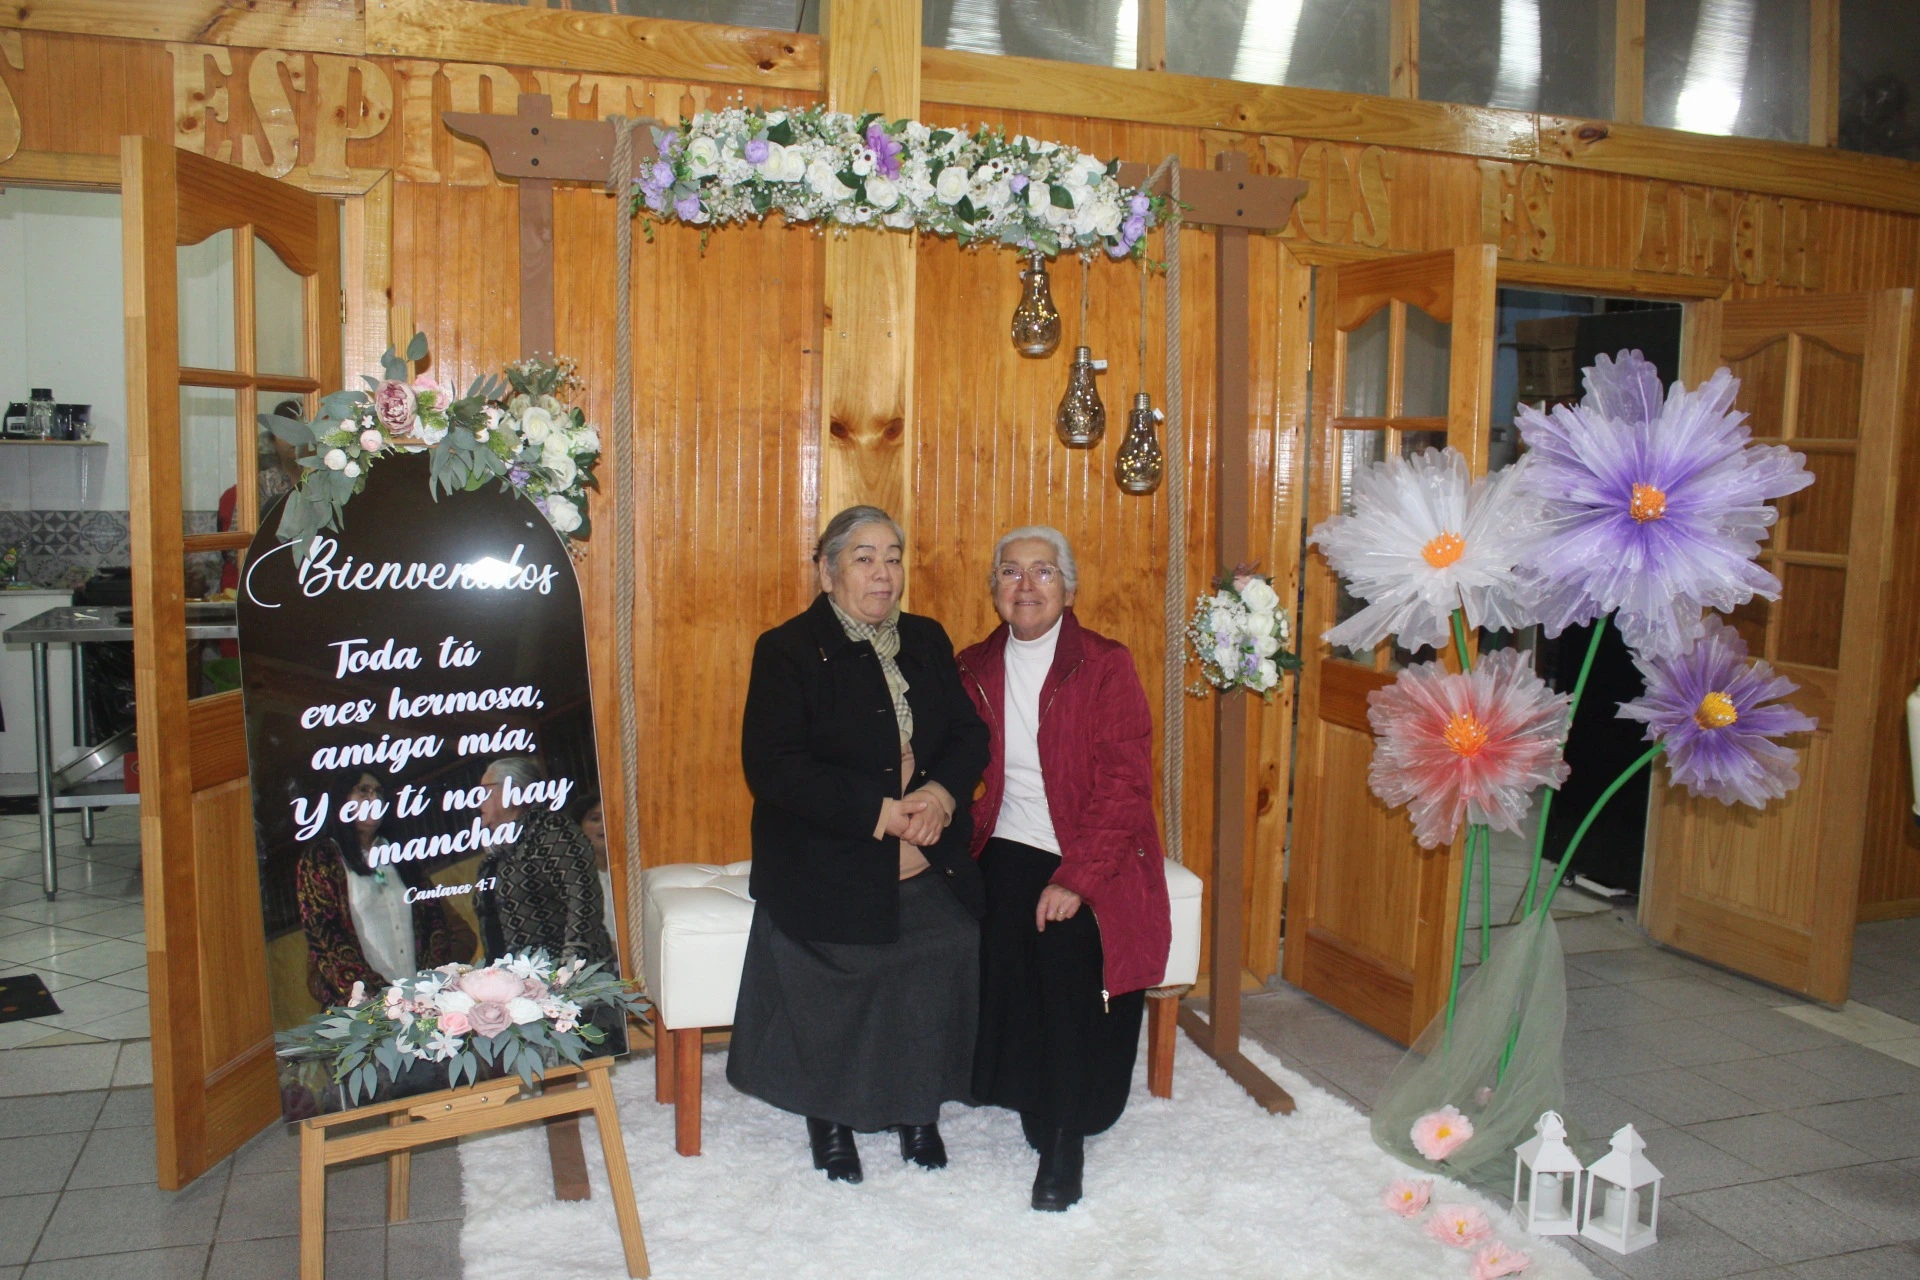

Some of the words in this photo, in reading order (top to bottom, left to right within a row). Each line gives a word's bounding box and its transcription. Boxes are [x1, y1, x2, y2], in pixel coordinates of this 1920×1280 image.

[328, 638, 423, 679] Toda
[439, 635, 482, 669] tú
[300, 699, 377, 729] eres
[388, 685, 544, 721] hermosa,
[311, 734, 445, 774] amiga
[458, 723, 536, 756] mía,
[290, 792, 329, 841] Y
[339, 798, 390, 823] en
[396, 784, 431, 819] tí
[442, 786, 493, 812] no
[501, 775, 574, 812] hay
[368, 816, 524, 869] mancha
[402, 883, 473, 905] Cantares
[474, 876, 497, 892] 4:7
